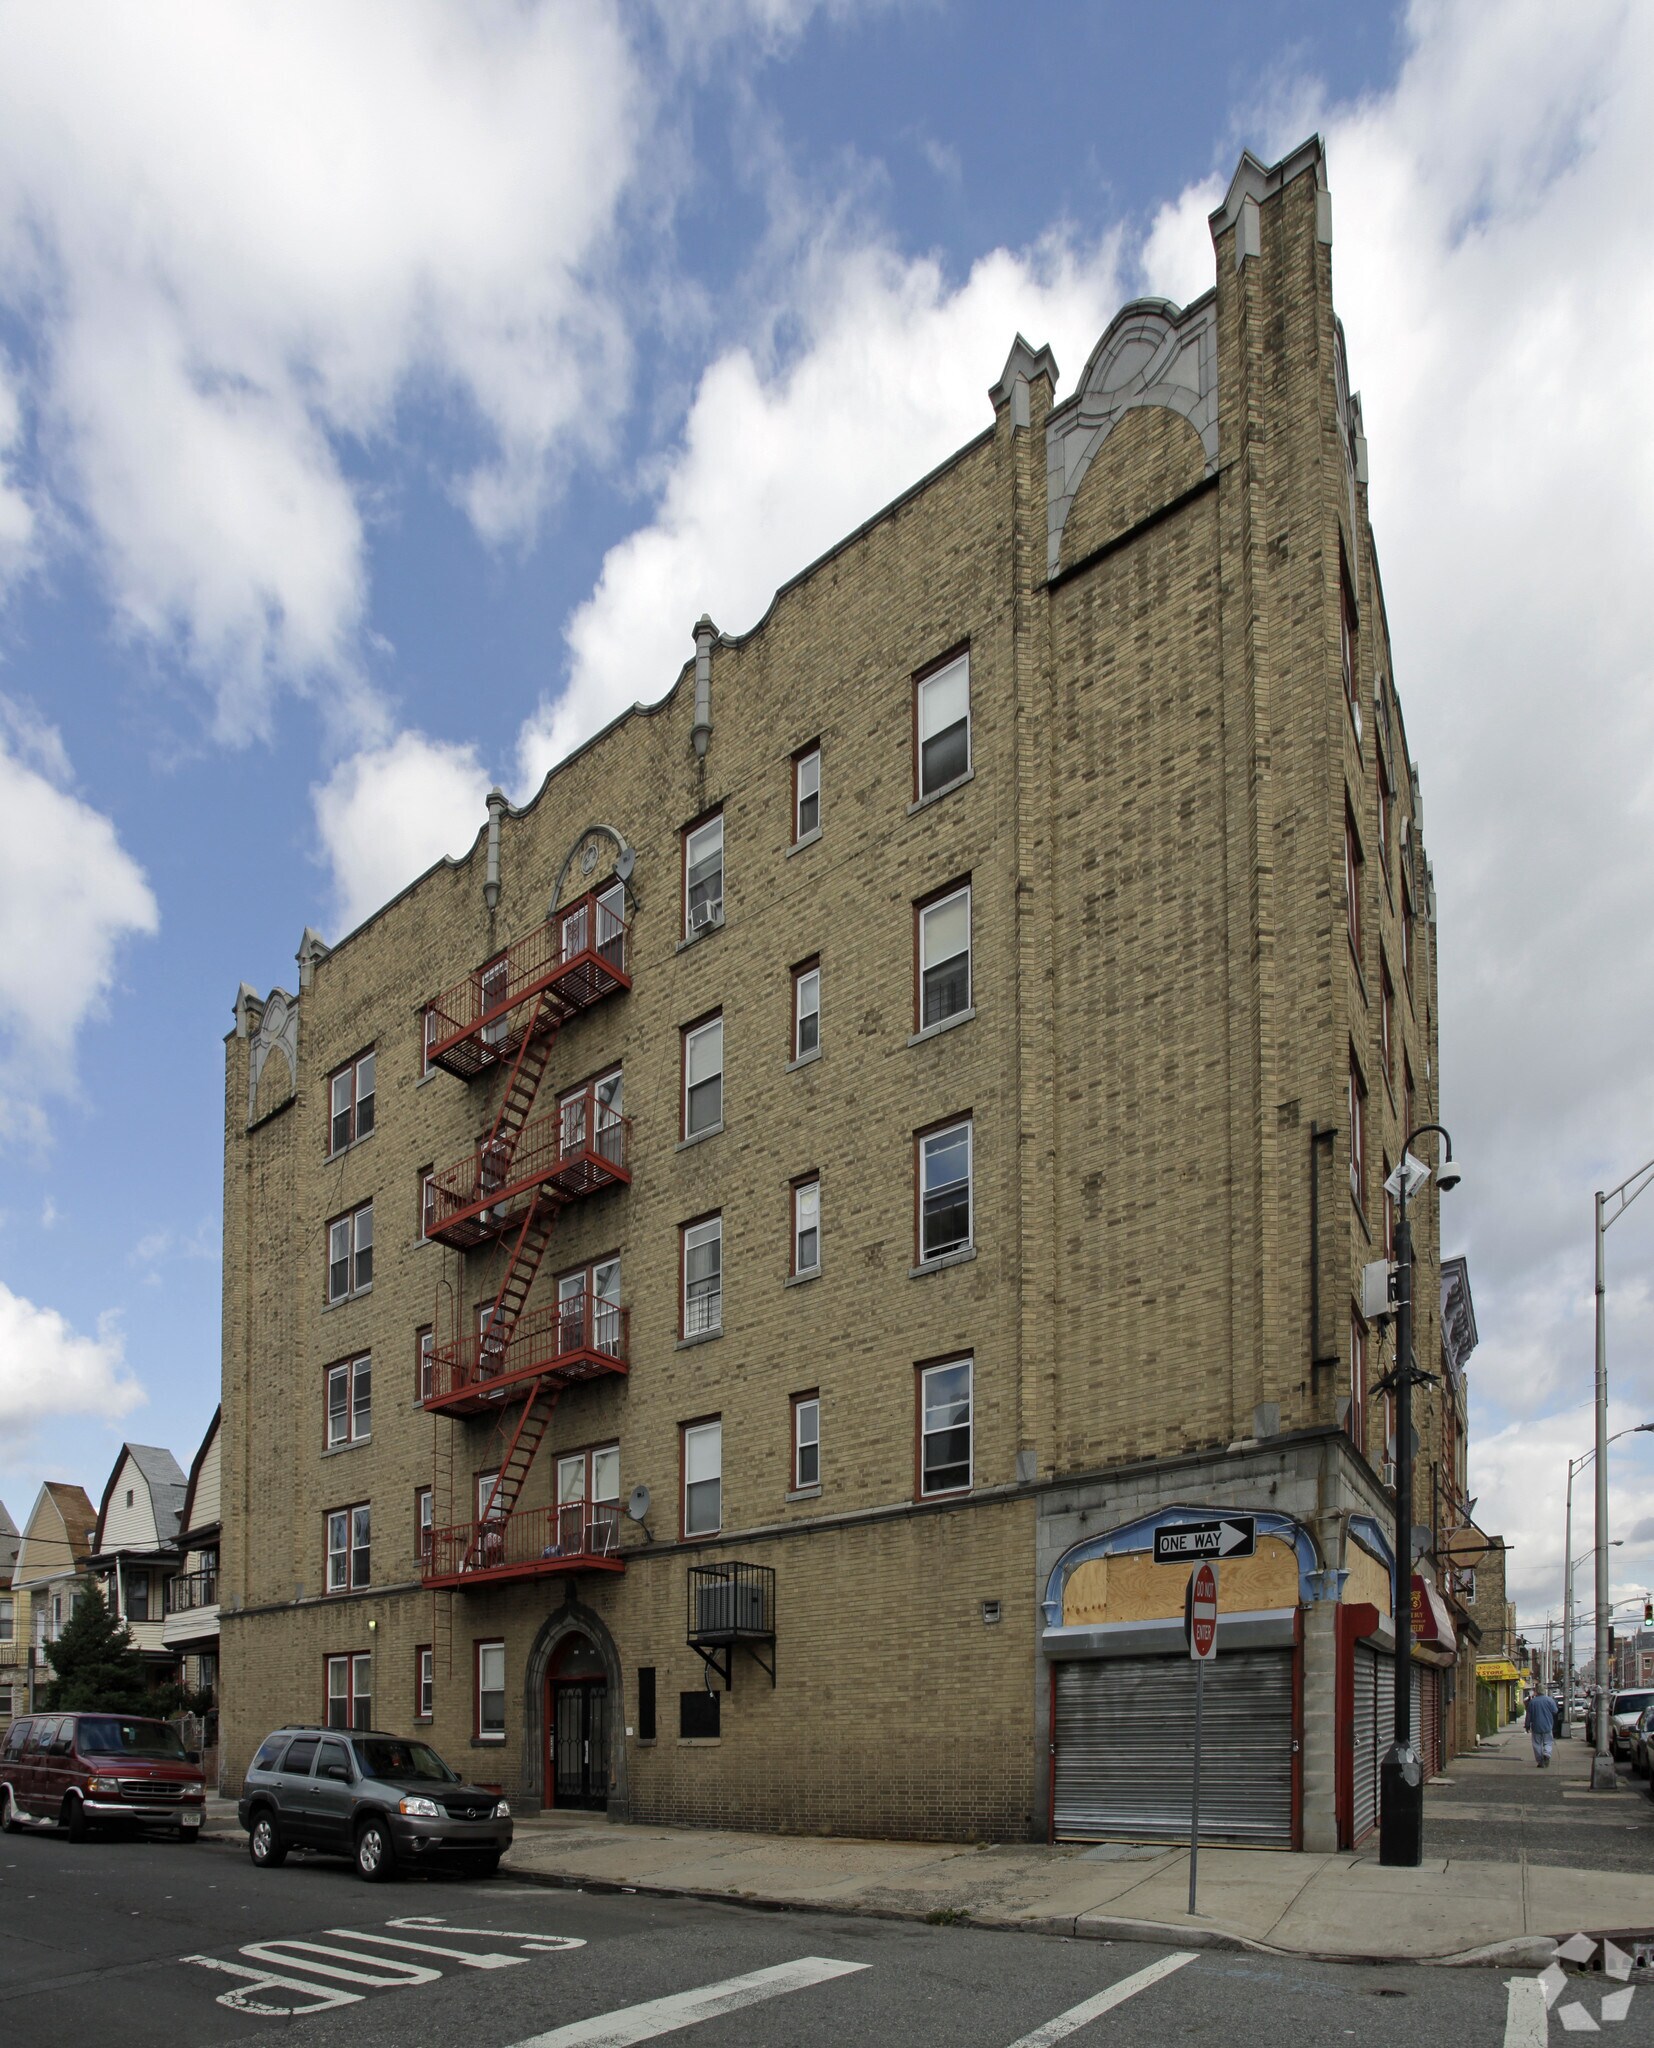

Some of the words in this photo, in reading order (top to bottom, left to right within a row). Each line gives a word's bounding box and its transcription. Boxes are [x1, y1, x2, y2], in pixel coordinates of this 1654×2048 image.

[1161, 1535, 1187, 1551] ONE
[1194, 1532, 1222, 1548] WAY
[1197, 1581, 1204, 1597] DO
[1205, 1582, 1214, 1598] NOT
[1196, 1624, 1211, 1640] ENTER
[179, 1917, 587, 2016] STOP
